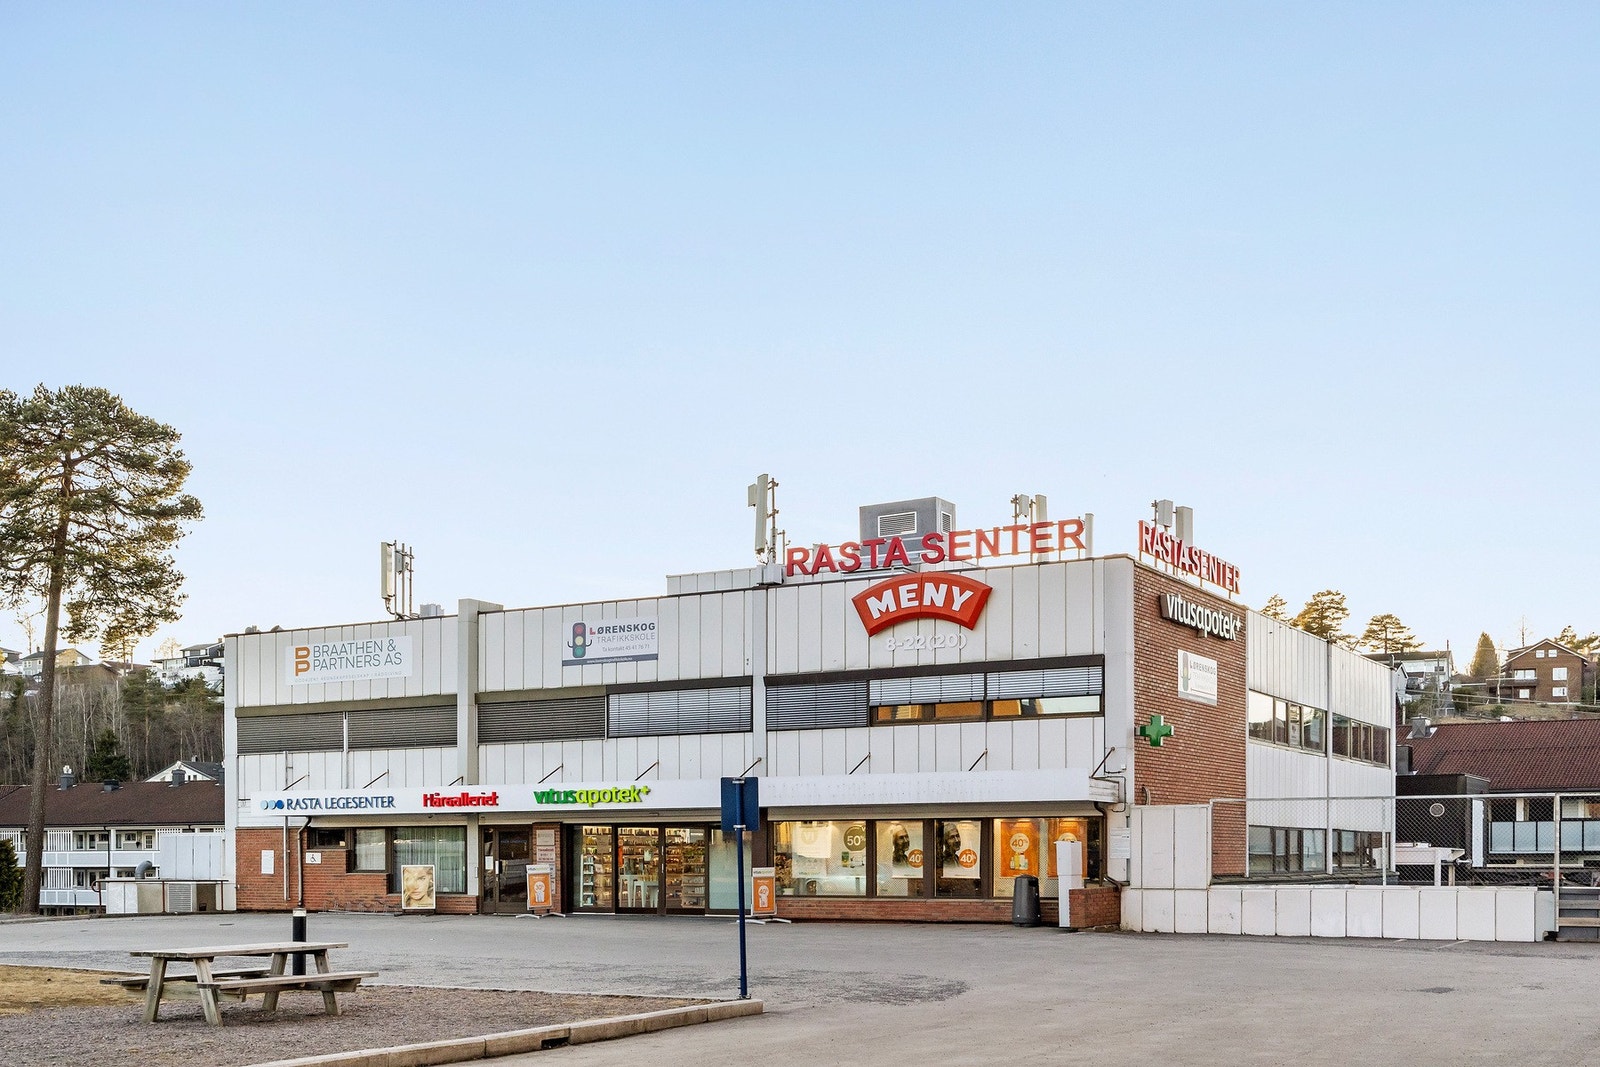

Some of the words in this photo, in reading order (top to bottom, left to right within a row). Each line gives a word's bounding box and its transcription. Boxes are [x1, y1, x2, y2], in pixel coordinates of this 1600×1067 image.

[786, 536, 912, 577] RASTA
[921, 518, 1087, 564] SENTER
[1138, 520, 1189, 571] RASTA
[1188, 545, 1241, 594] SENTER
[866, 582, 974, 620] MENY
[589, 622, 656, 635] LØRENSKOG
[597, 632, 656, 643] TRAFIKKSKOLE
[313, 640, 383, 658] BRAATHEN
[387, 639, 396, 652] &
[313, 654, 381, 671] PARTNERS
[384, 652, 402, 665] AS
[286, 797, 323, 810] RASTA
[324, 796, 396, 809] LEGESENTER
